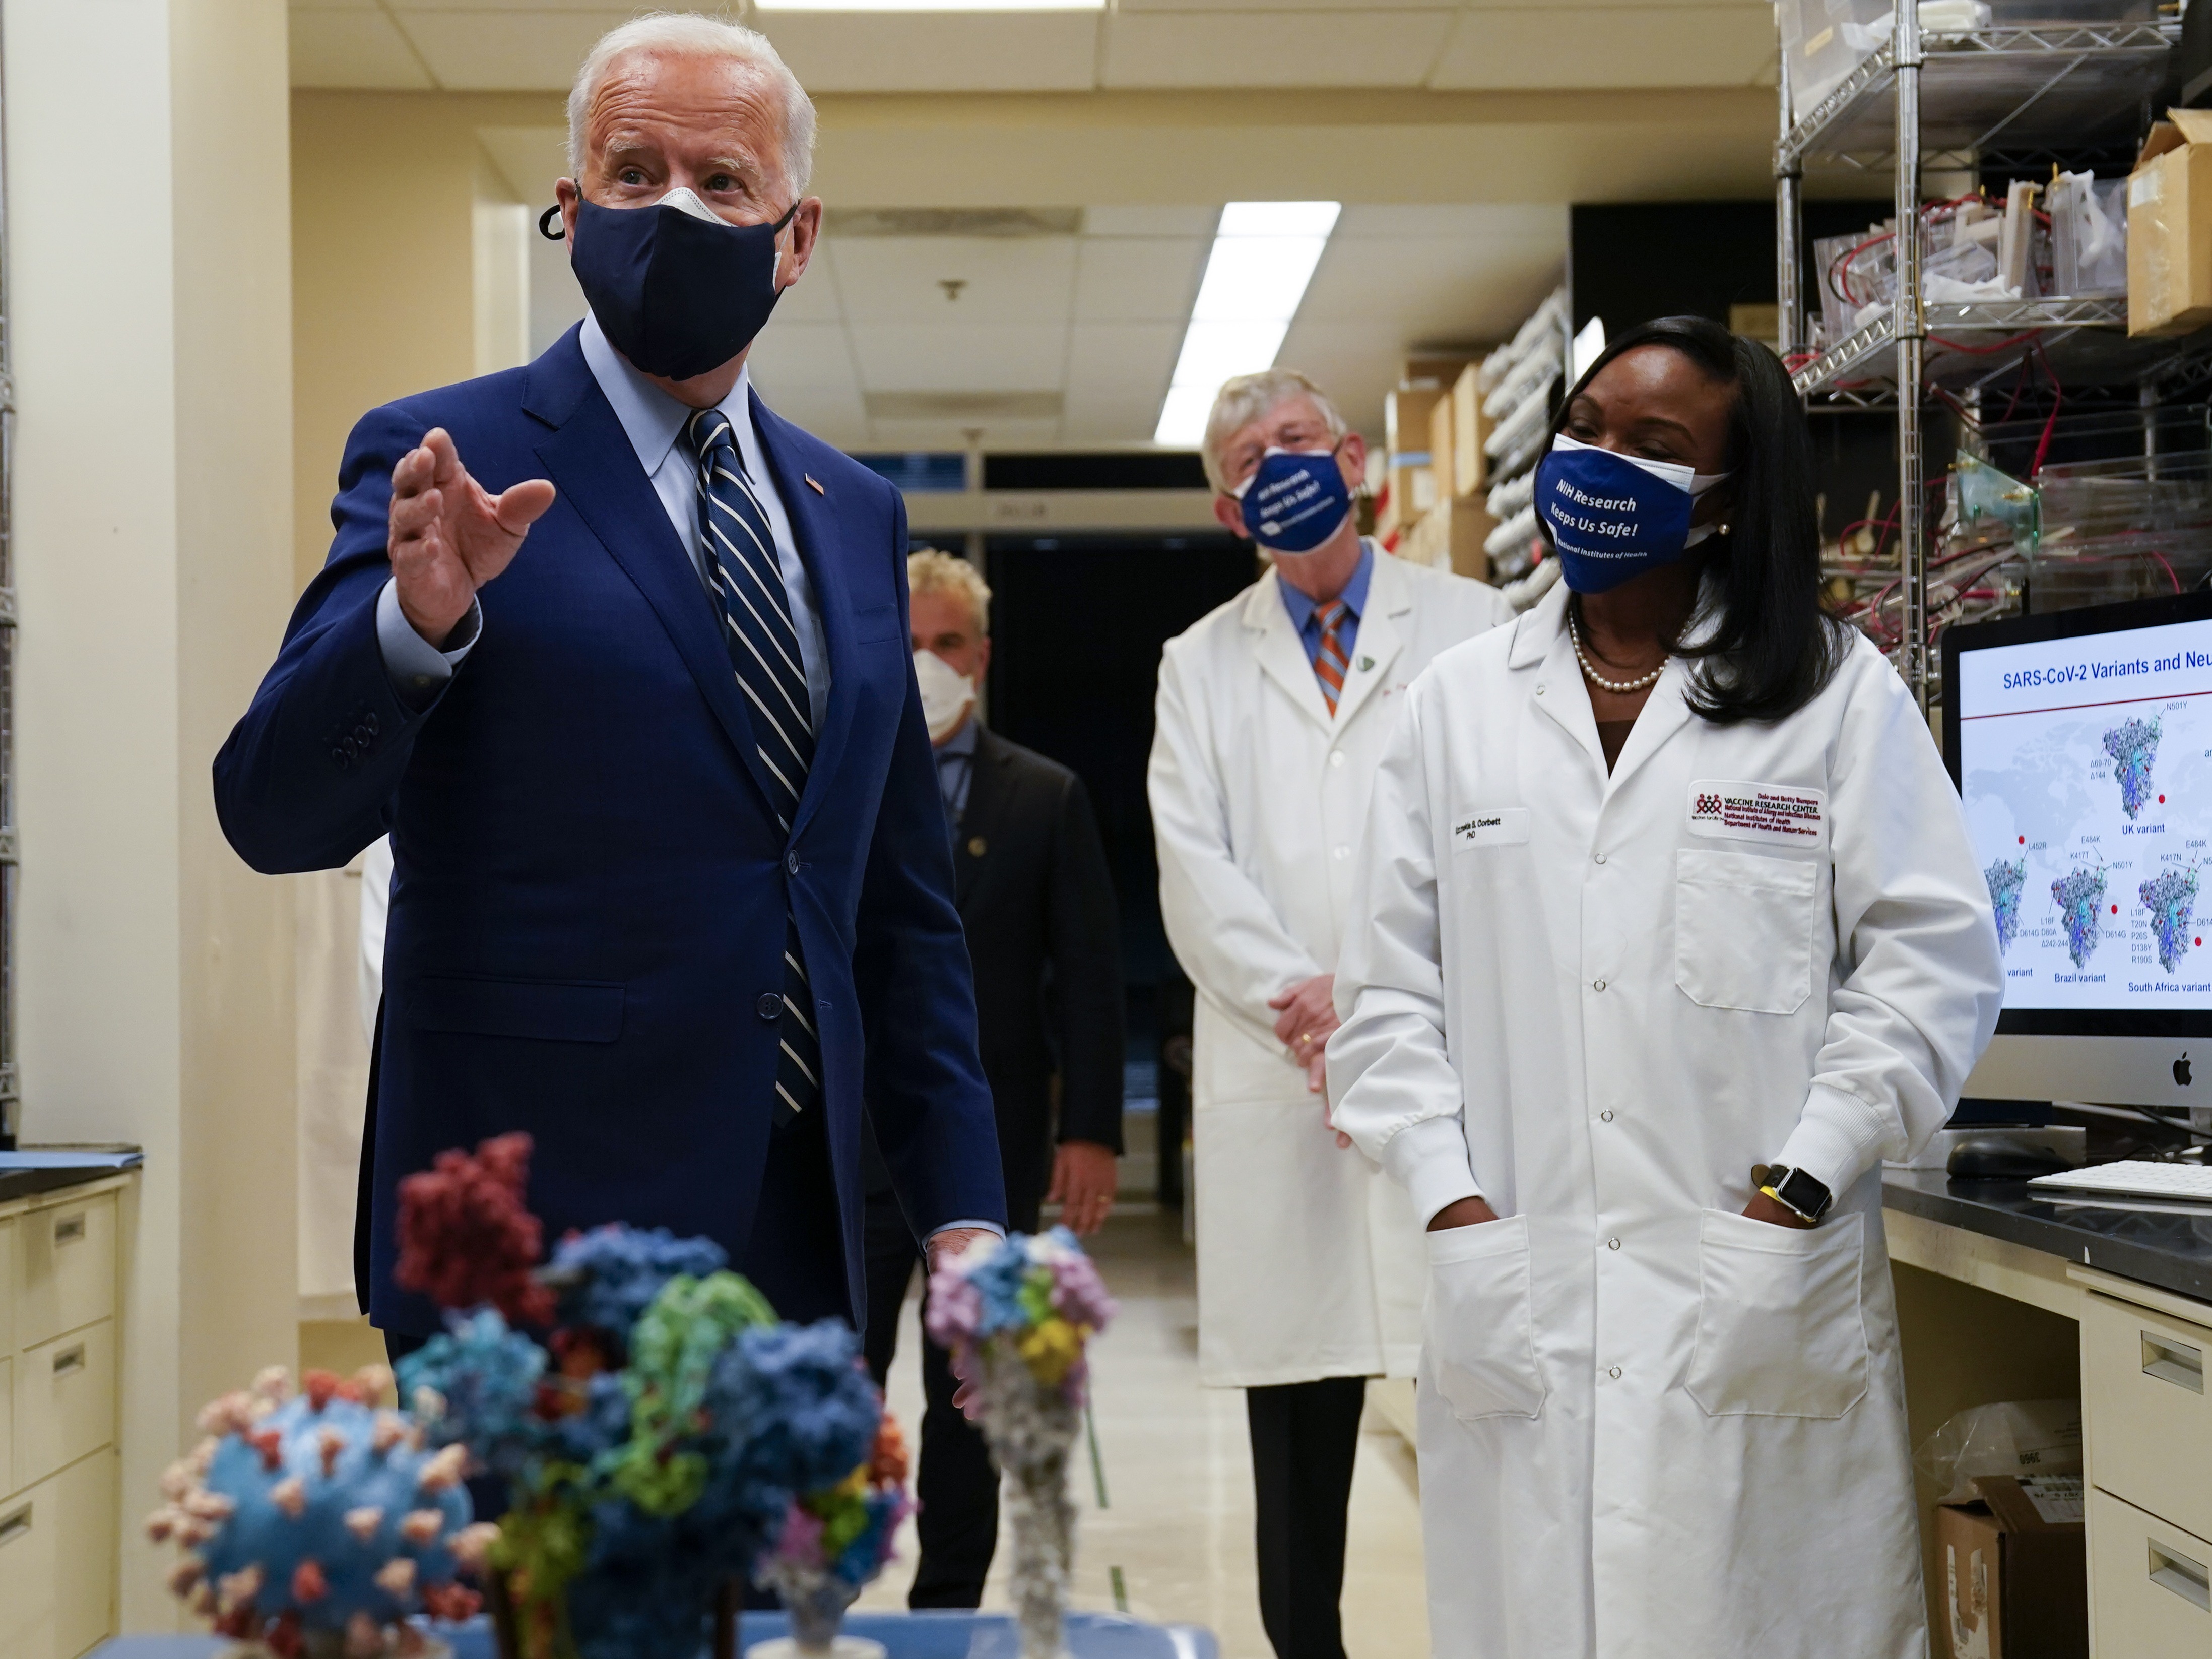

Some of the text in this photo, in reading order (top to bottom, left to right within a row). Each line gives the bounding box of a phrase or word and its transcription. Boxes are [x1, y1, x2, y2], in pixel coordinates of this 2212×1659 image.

[1556, 479, 1636, 512] NIH Research
[1551, 501, 1638, 538] Keeps Us Safe!
[1558, 538, 1580, 554] National
[1581, 548, 1614, 558] Institutes
[2003, 665, 2087, 689] SARS-CoV-2
[2092, 658, 2149, 679] Variants
[2154, 653, 2180, 671] and
[2167, 701, 2188, 711] N501Y
[1724, 798, 1818, 813] VACCINE RESEARCH CENTER
[1796, 797, 1818, 805] Bumpers
[1477, 818, 1501, 827] Corbett
[1746, 814, 1767, 822] Institutes
[1724, 820, 1750, 828] Department
[2122, 823, 2165, 835] UK variant
[2081, 836, 2100, 844] E484K
[2186, 839, 2206, 848] E484K
[2161, 853, 2181, 862] K417N
[2113, 861, 2133, 869] N501Y
[2106, 930, 2126, 938] D614G
[2007, 968, 2033, 977] variant
[2055, 973, 2106, 982] Brazil variant
[2128, 982, 2210, 992] South Africa variant
